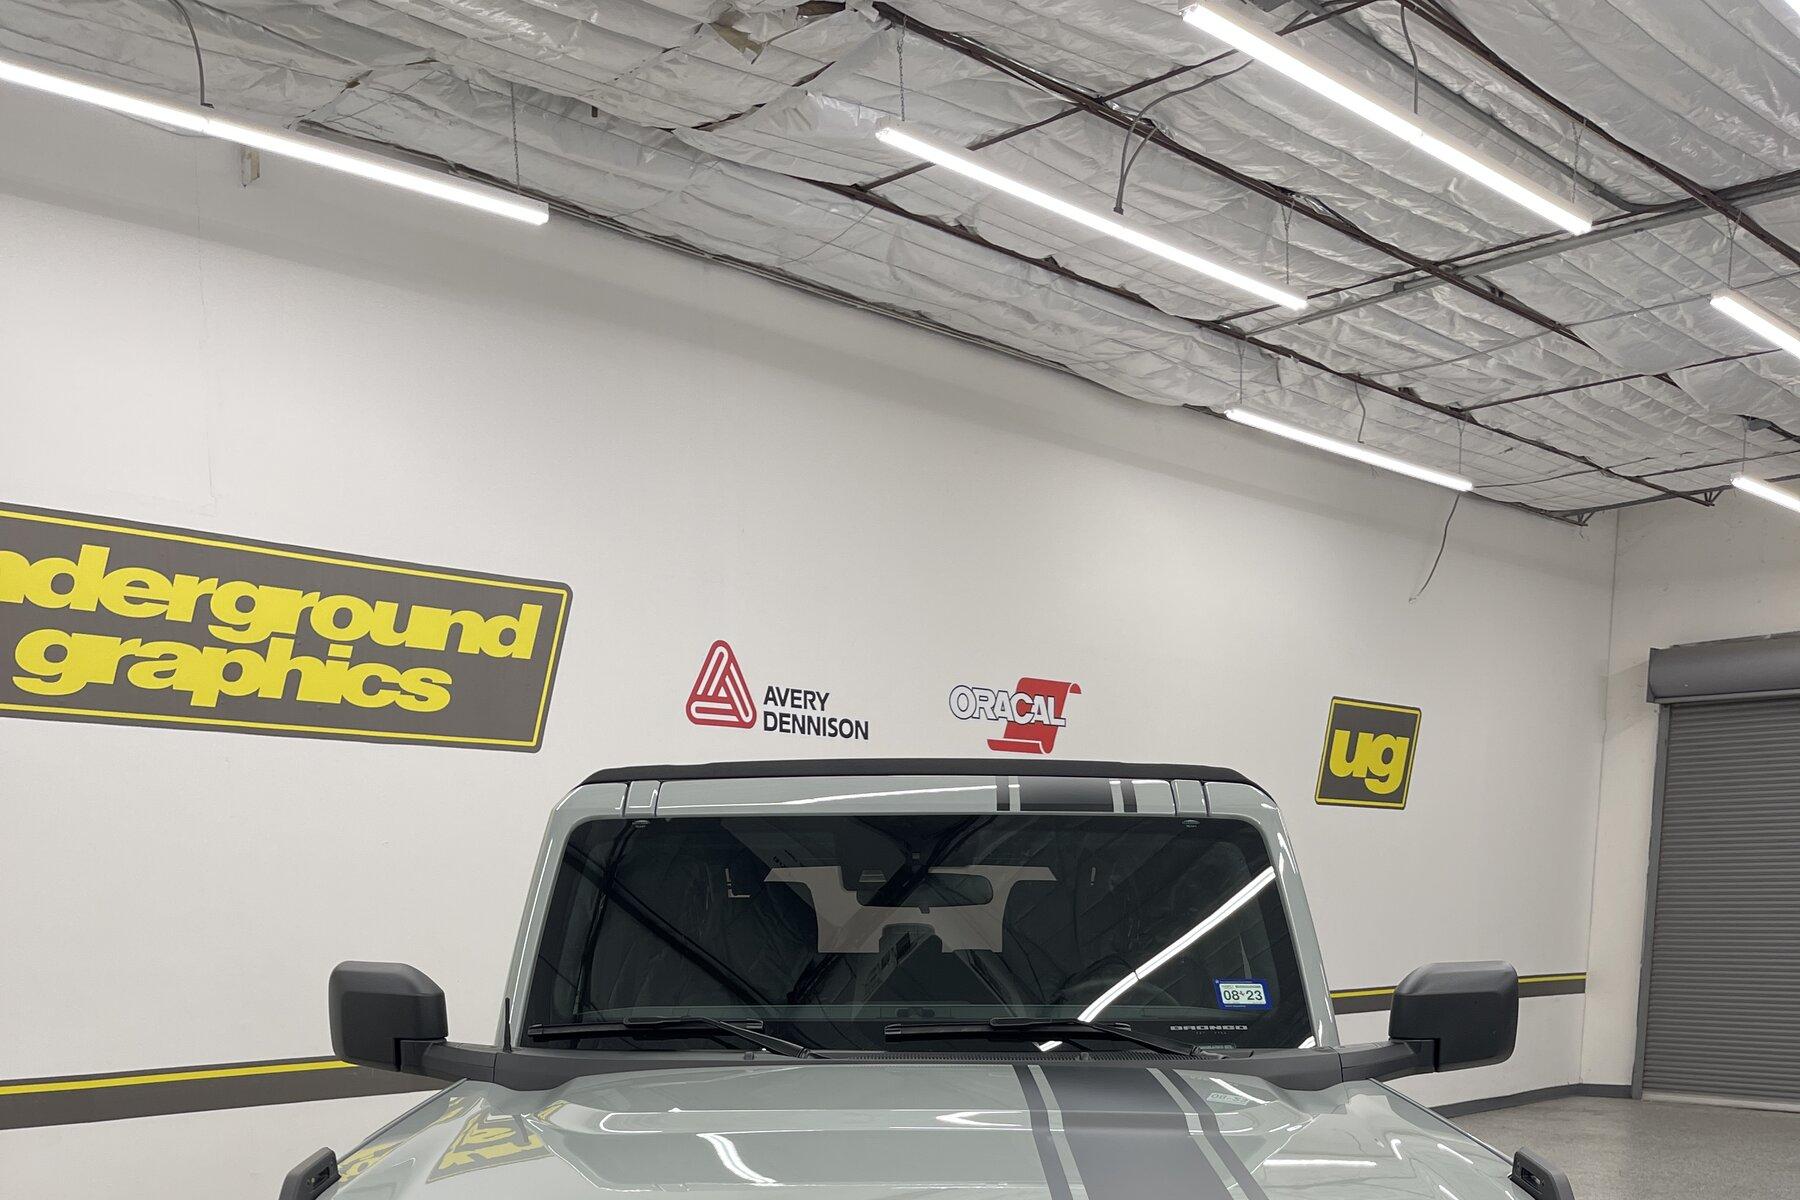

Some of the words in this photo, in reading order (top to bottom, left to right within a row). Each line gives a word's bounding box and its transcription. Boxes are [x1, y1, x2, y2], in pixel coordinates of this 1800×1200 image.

[12, 628, 453, 713] graphics
[763, 685, 830, 712] AVERY
[949, 684, 1067, 727] ORACAL
[763, 710, 869, 741] DENNISON
[1329, 729, 1410, 795] ug
[1223, 989, 1240, 1001] 08
[1246, 989, 1263, 1001] 23
